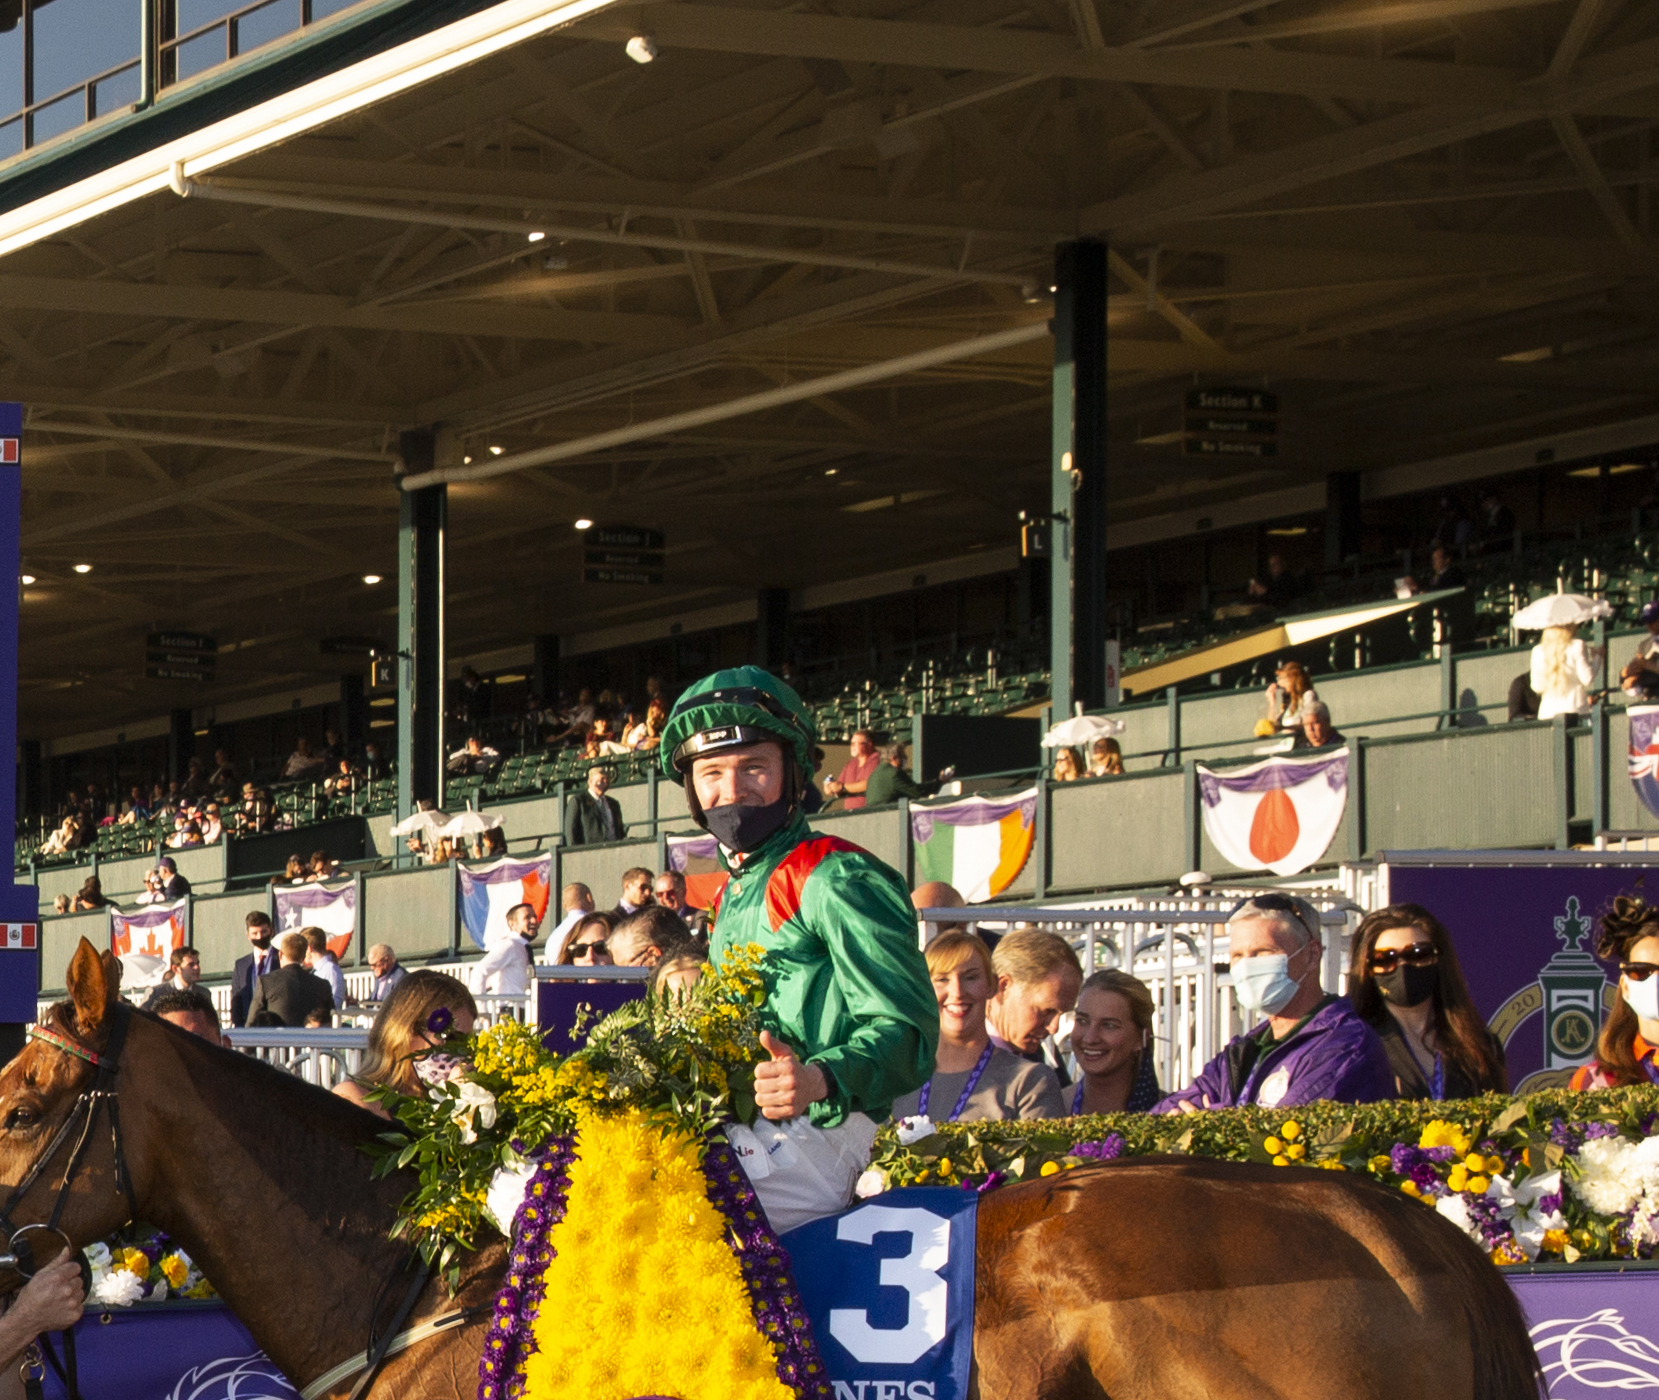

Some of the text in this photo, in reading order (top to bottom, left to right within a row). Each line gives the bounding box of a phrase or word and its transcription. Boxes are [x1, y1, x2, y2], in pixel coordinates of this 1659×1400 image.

[1199, 392, 1248, 408] Section
[1034, 533, 1043, 549] L
[380, 668, 390, 682] K
[1511, 993, 1536, 1016] 20
[829, 1203, 951, 1364] 3
